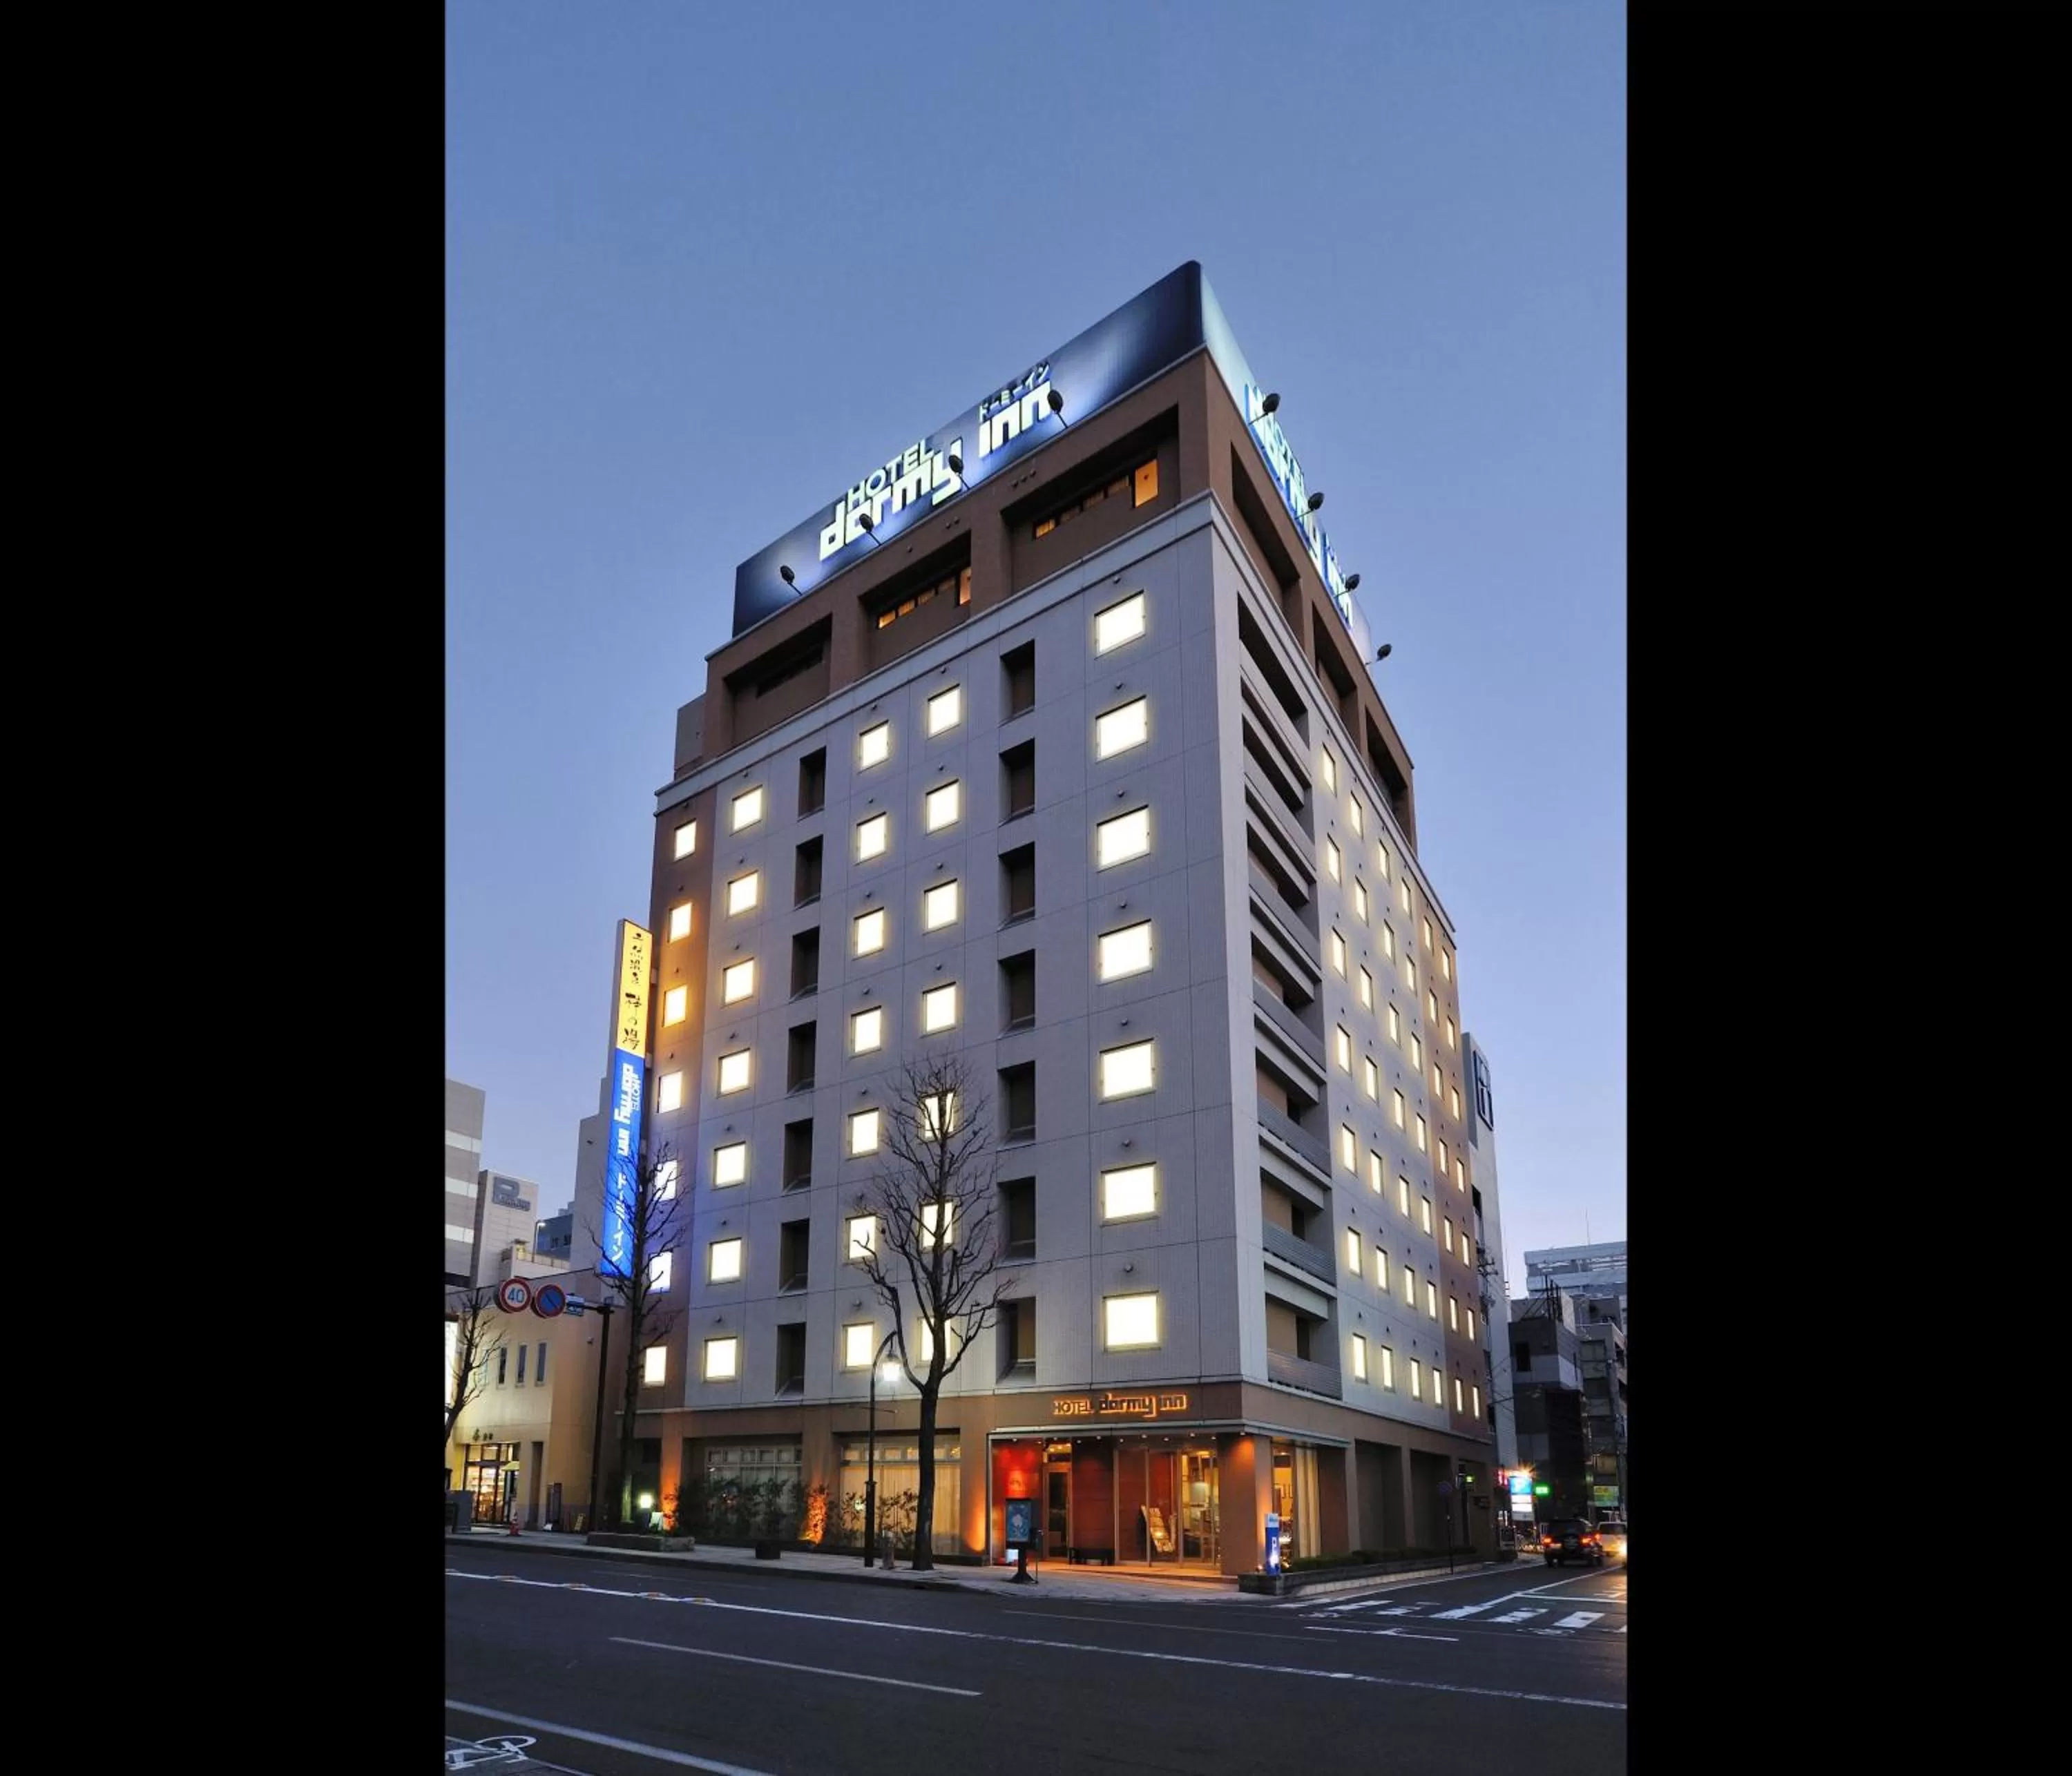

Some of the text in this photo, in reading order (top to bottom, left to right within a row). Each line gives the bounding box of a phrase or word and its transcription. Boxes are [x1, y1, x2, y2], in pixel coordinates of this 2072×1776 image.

[819, 380, 1051, 562] dormy inn
[847, 438, 934, 512] HOTEL
[611, 1172, 627, 1262] ドーミーイン
[507, 1286, 525, 1304] 40
[1053, 1392, 1188, 1418] HOTEL dormy inn
